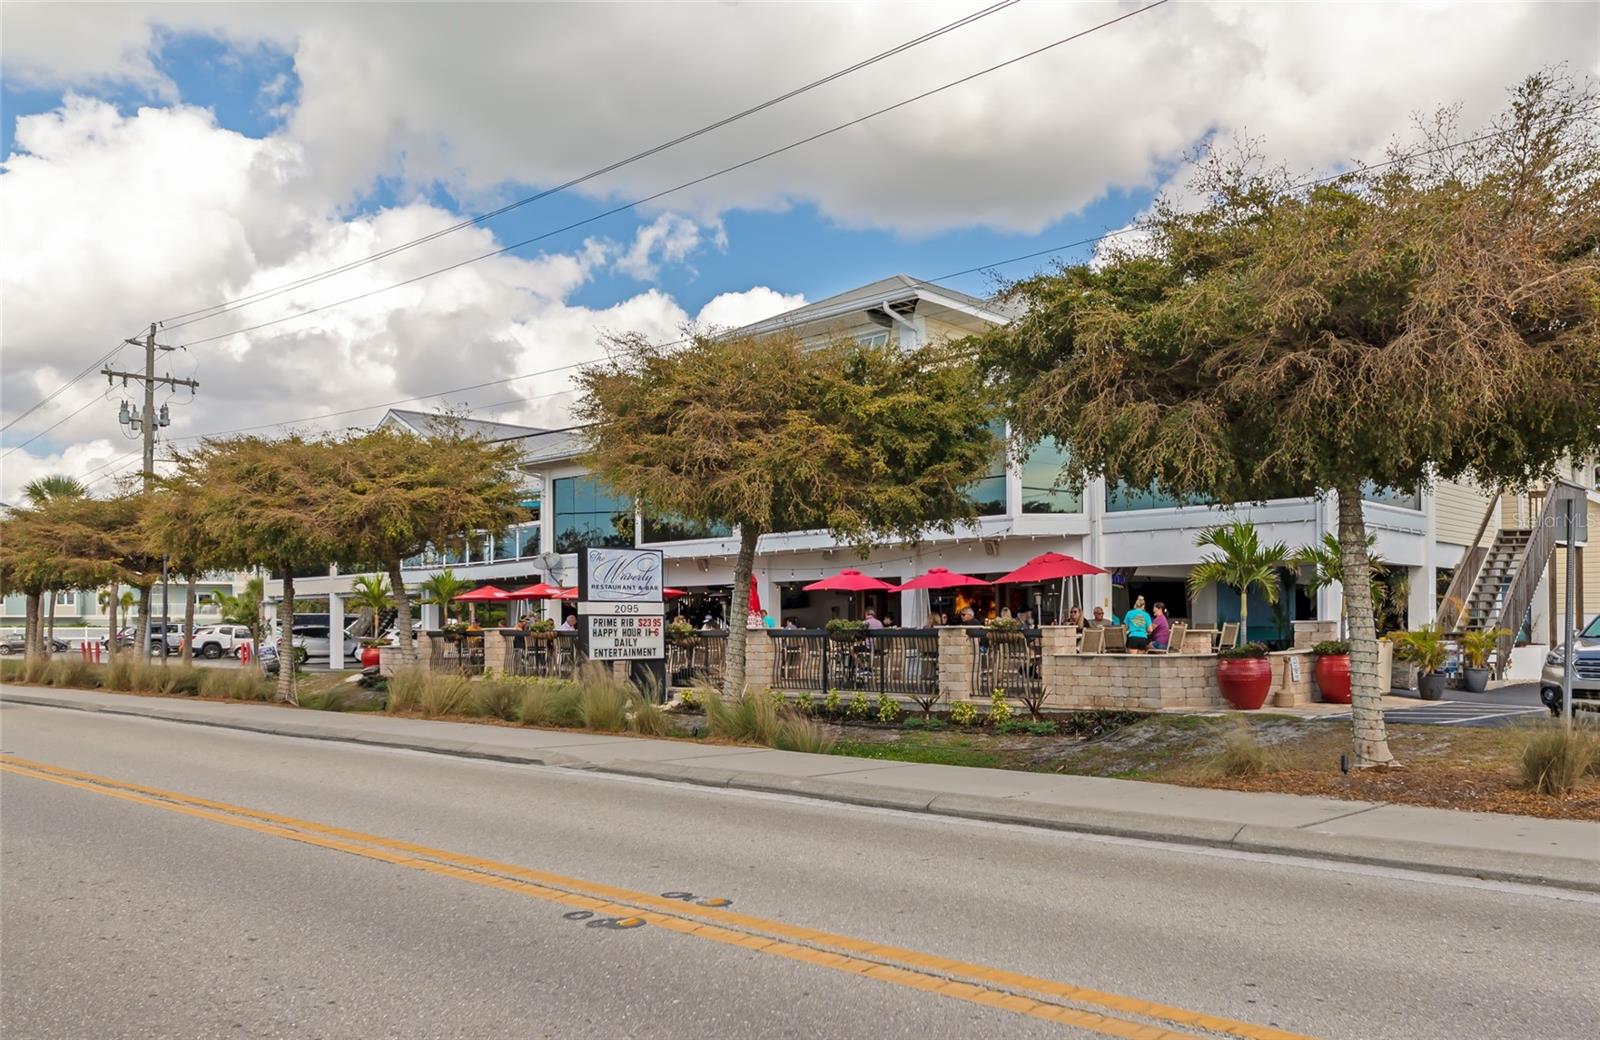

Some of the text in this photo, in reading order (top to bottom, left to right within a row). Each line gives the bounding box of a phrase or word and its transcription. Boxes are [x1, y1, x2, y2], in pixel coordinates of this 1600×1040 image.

[589, 550, 605, 562] The
[593, 553, 660, 588] Waverly
[614, 604, 639, 613] 2095
[593, 618, 617, 627] PRIME
[621, 618, 634, 627] RIB
[592, 628, 618, 637] HAPPY
[622, 628, 642, 637] HOUR
[614, 638, 638, 647] DAILY
[594, 647, 657, 657] ENTERTAINMENT
